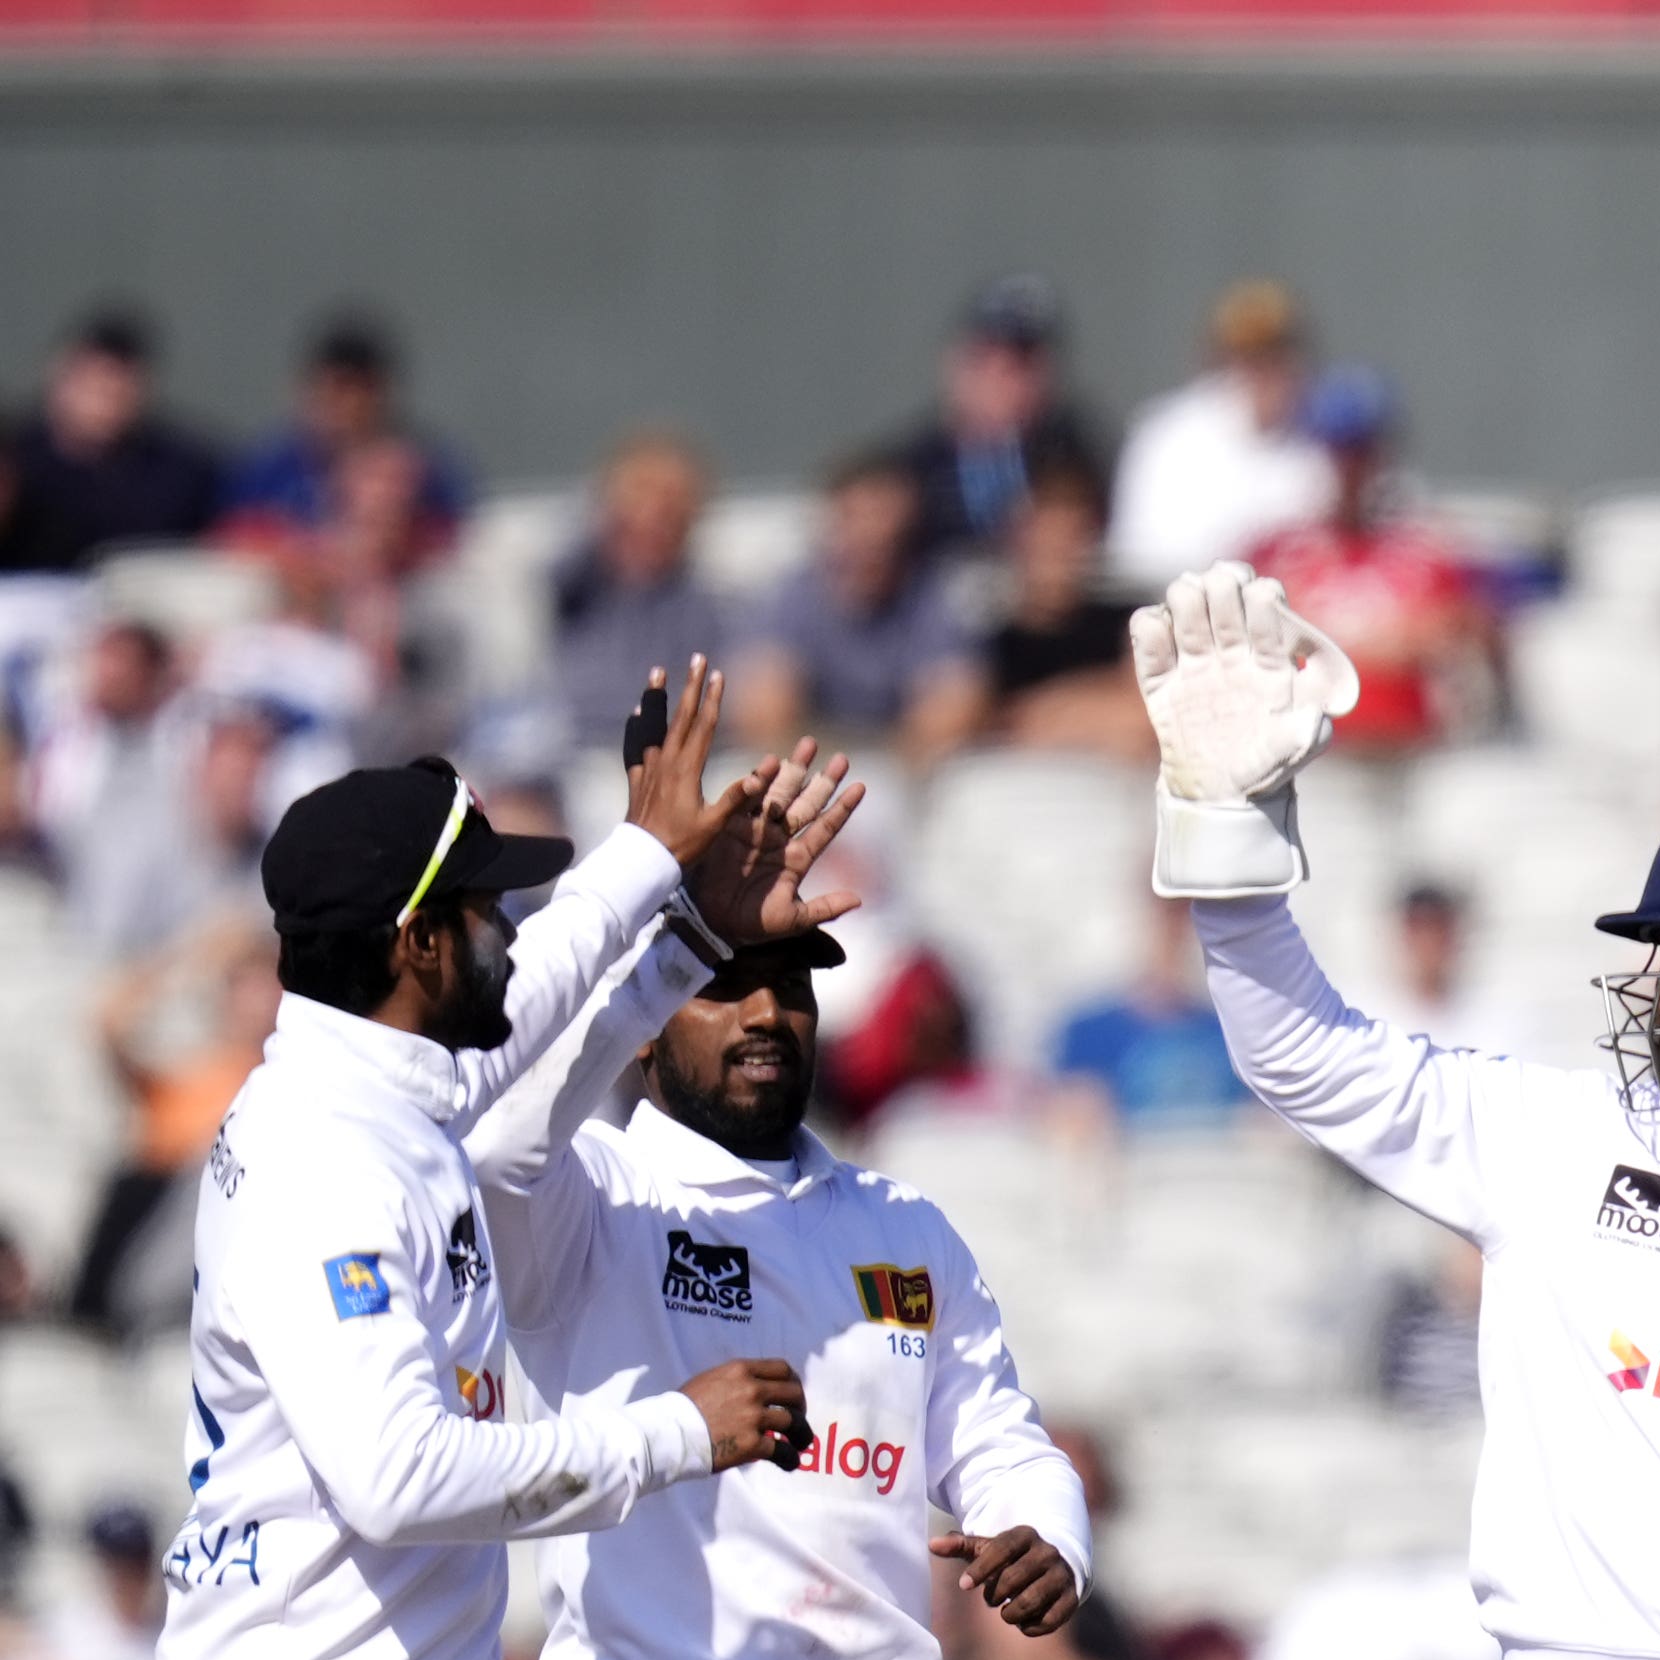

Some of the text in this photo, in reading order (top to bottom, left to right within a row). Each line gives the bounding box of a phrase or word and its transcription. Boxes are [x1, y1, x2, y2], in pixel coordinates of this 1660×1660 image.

[662, 1272, 753, 1311] moose
[709, 1307, 752, 1323] COMPANY
[887, 1333, 926, 1358] 163
